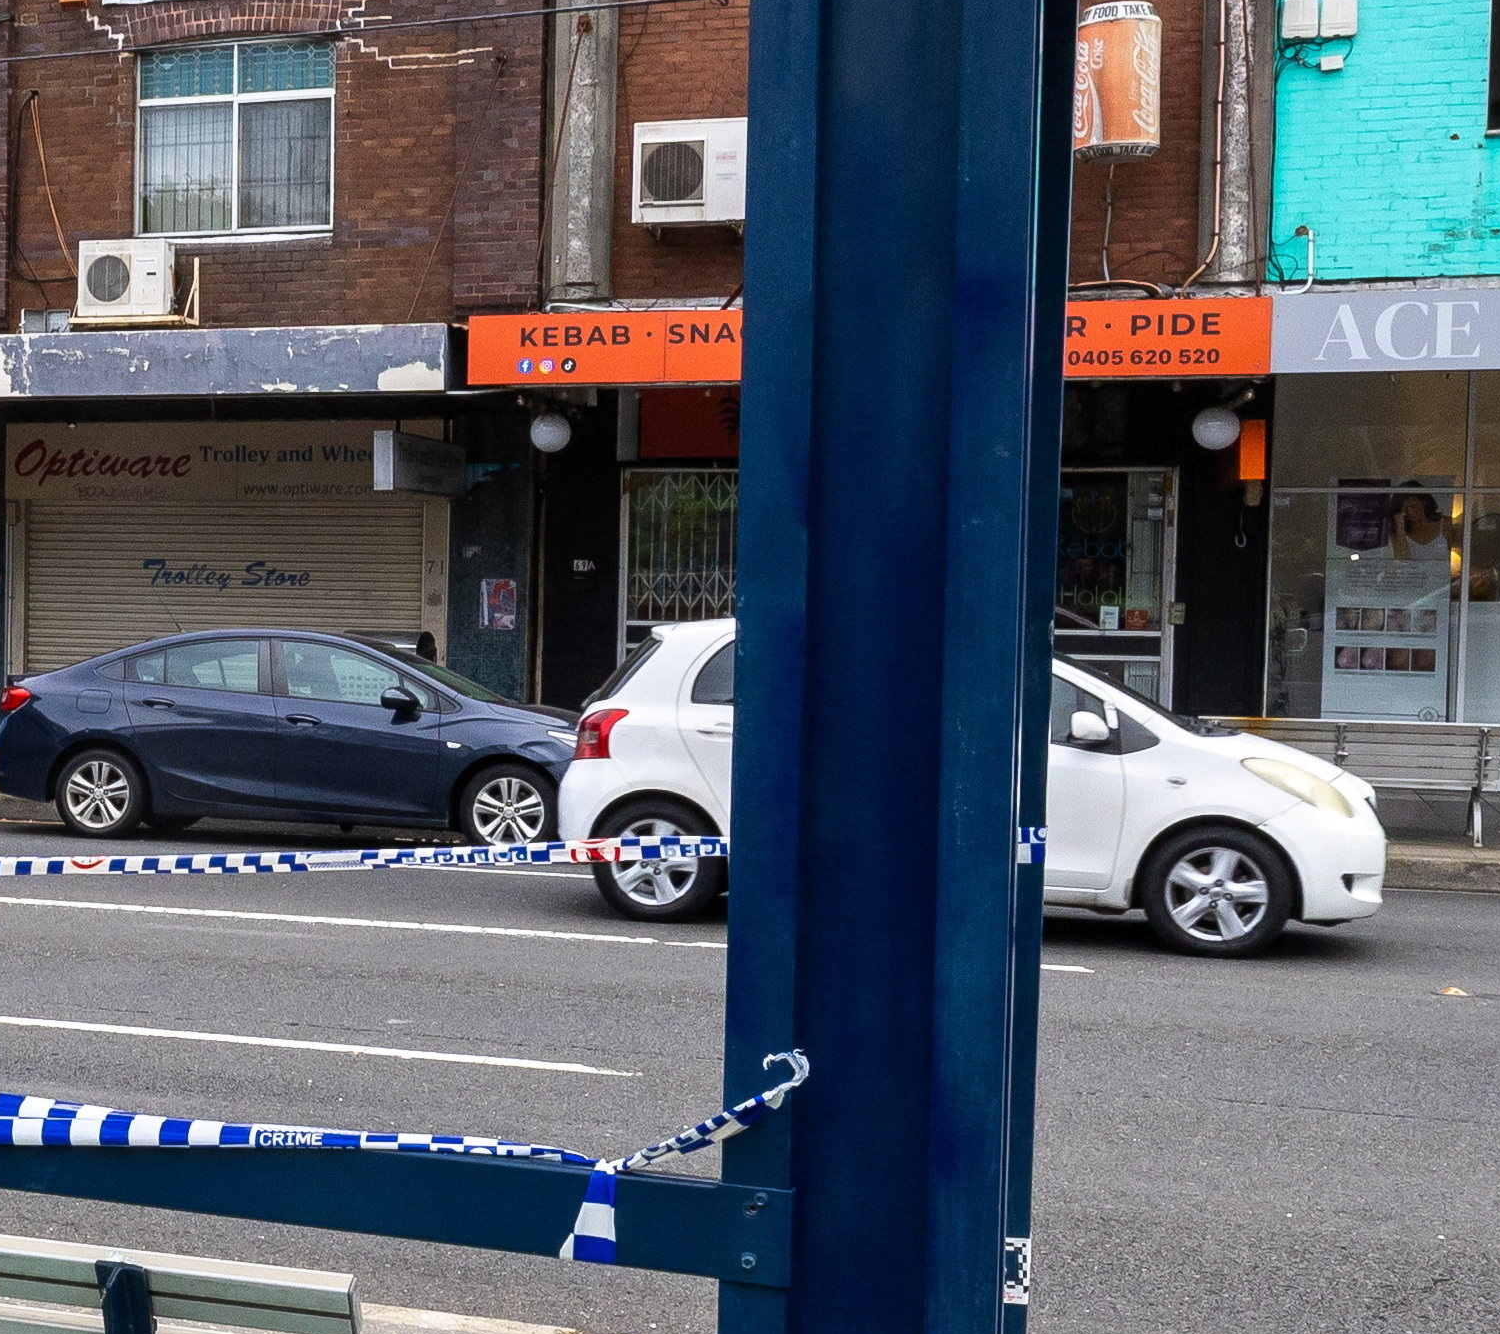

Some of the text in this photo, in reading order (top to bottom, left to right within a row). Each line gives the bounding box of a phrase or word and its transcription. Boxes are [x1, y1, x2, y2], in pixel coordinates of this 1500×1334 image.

[1092, 4, 1147, 18] FOOD TAKE
[520, 325, 631, 347] KEBAB
[668, 323, 743, 345] SNA
[1130, 312, 1221, 336] PIDE
[1314, 299, 1481, 361] ACE
[1067, 348, 1220, 365] 0405 620 520
[14, 439, 193, 486] Optiware
[199, 444, 313, 464] Trolley and
[143, 558, 312, 590] Trolley Store
[258, 1131, 324, 1146] CRIME
